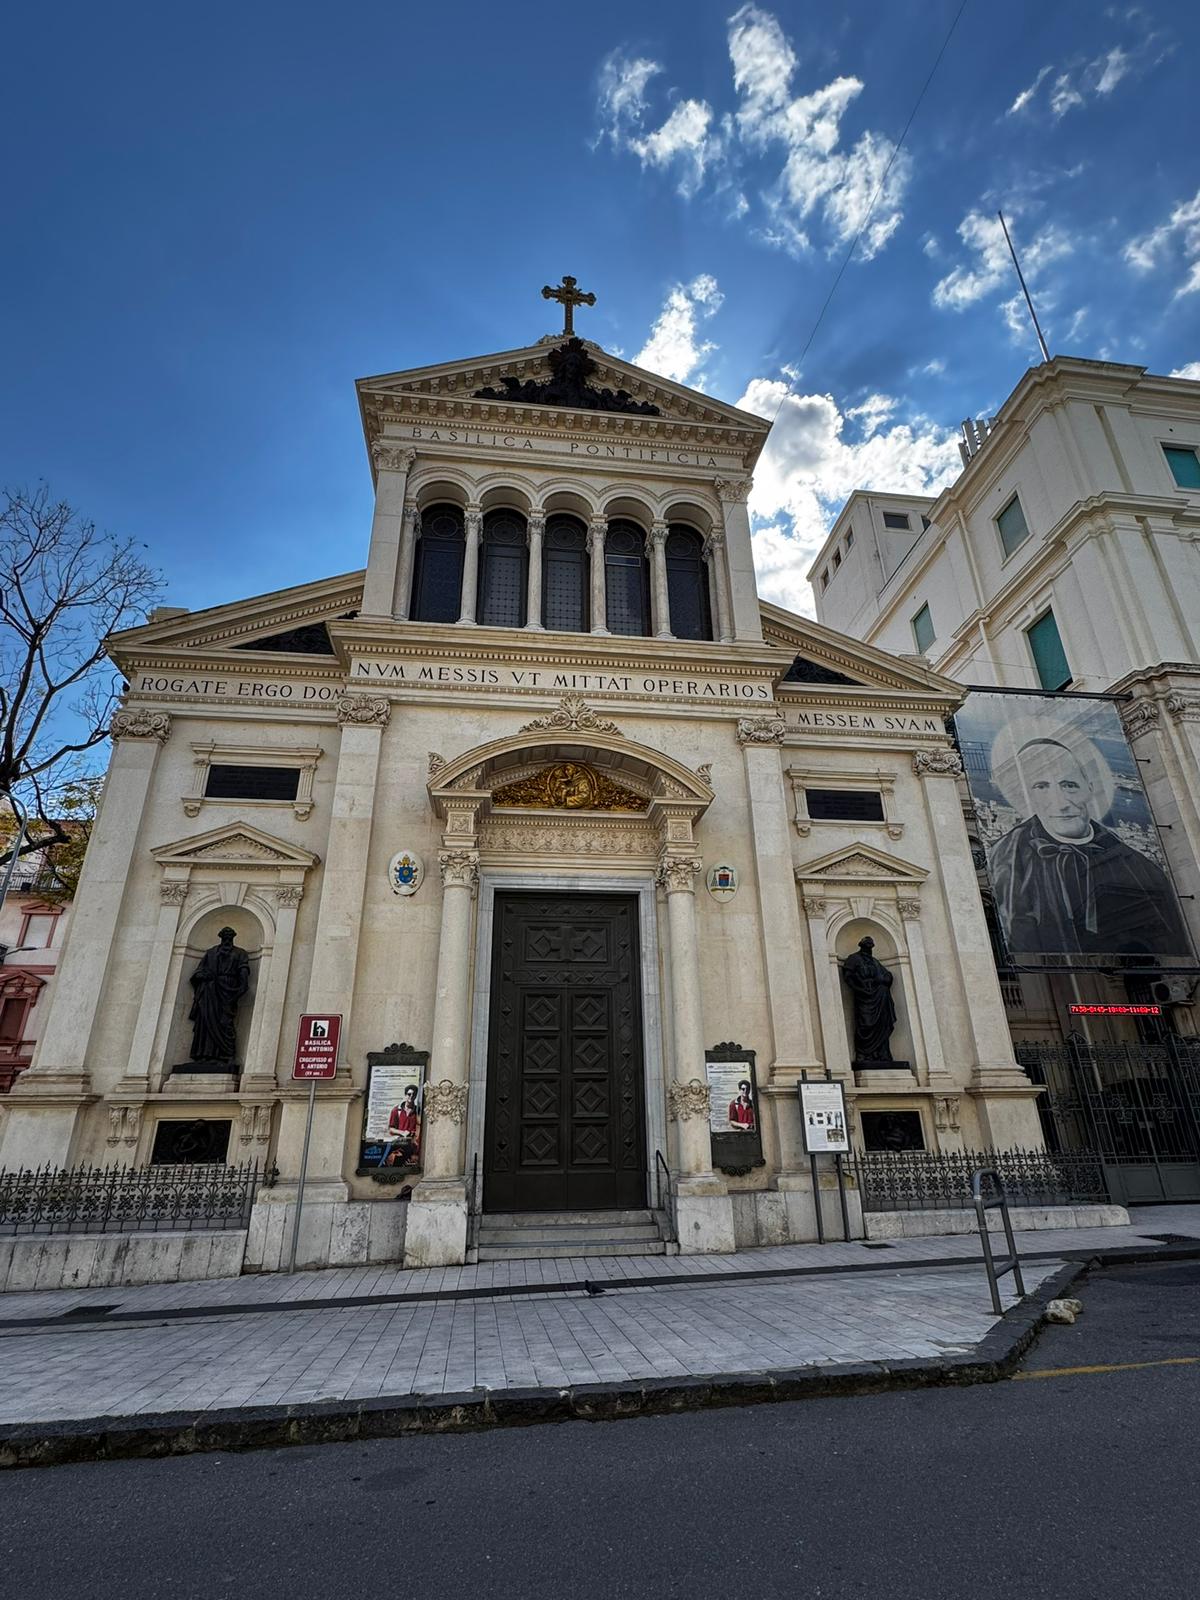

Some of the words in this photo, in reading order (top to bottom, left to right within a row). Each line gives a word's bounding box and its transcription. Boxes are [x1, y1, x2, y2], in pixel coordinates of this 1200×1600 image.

[412, 427, 533, 449] BASILICA
[570, 442, 717, 467] PONTIFICIA
[140, 677, 228, 694] ROGATE
[237, 682, 293, 698] ERGO
[357, 662, 405, 678] NVM
[418, 666, 499, 683] MESSIS
[511, 671, 542, 686] VT
[552, 674, 632, 691] MITTAT
[643, 678, 768, 699] OPERARIOS
[798, 713, 875, 729] MESSEM
[884, 717, 937, 731] SVAM
